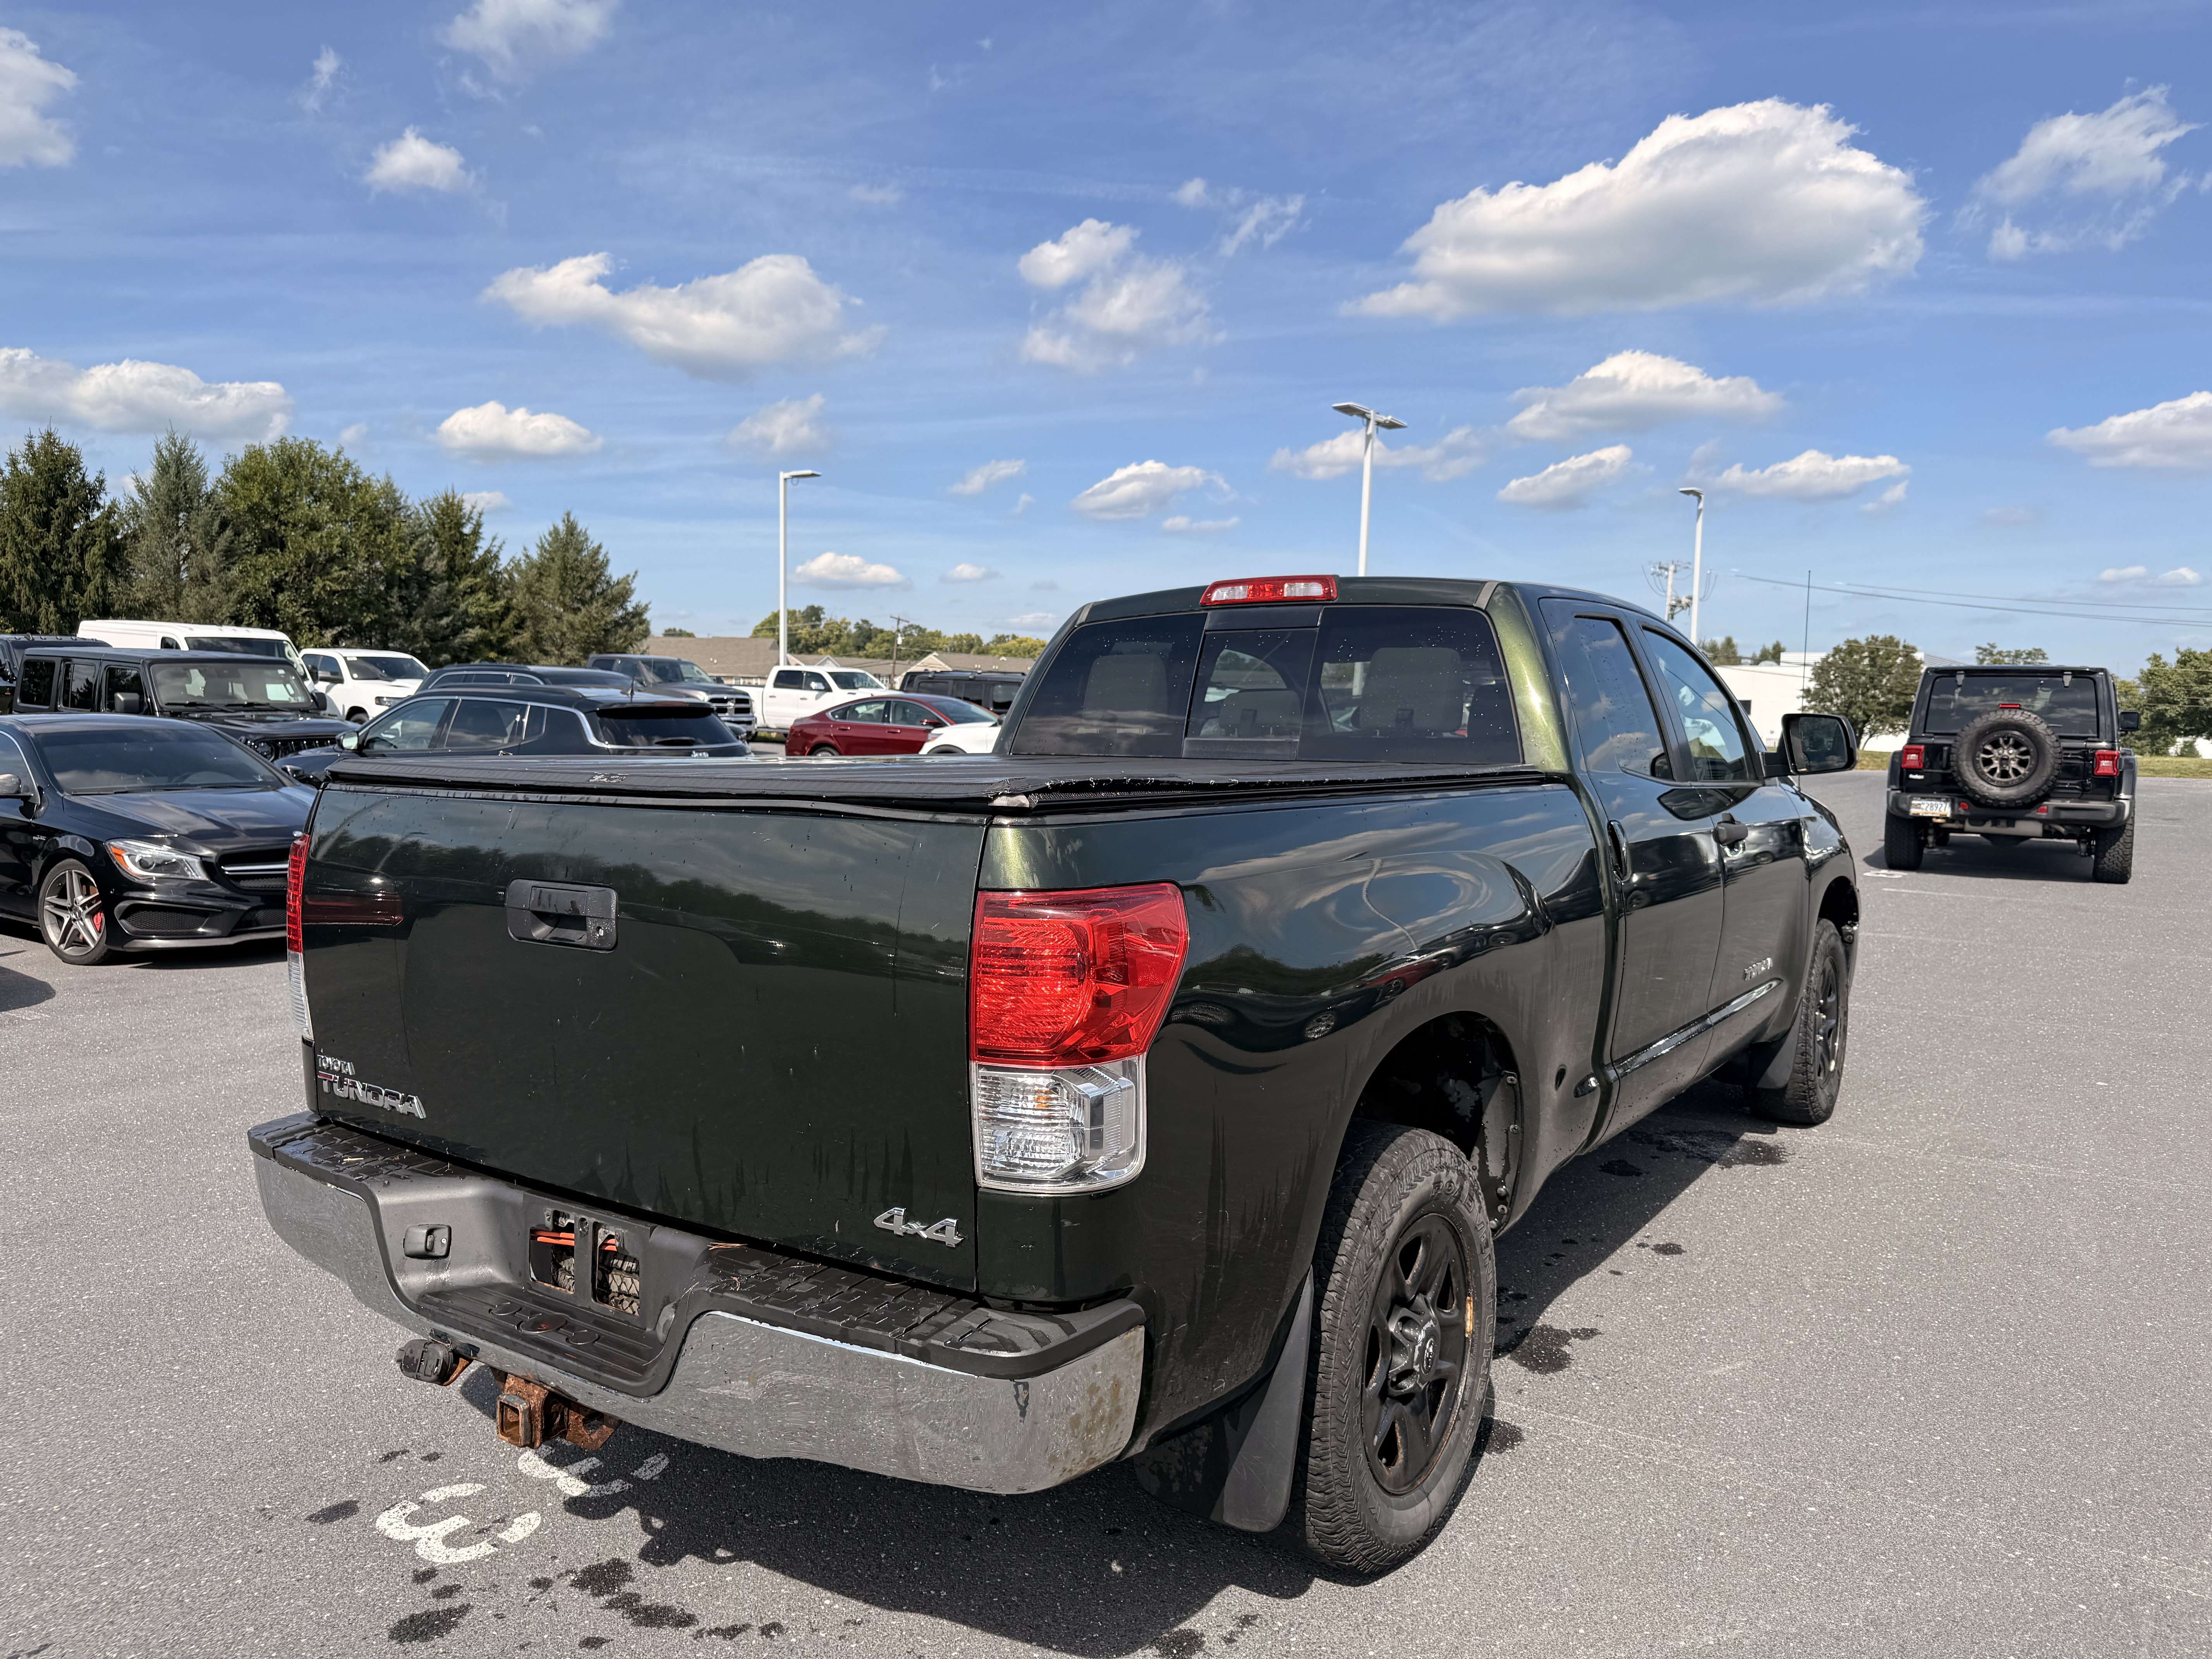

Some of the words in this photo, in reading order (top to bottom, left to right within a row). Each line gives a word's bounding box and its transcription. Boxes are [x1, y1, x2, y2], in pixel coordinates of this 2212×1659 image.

[317, 1054, 356, 1075] TOYOTA
[318, 1071, 426, 1119] TUNDRA
[1431, 1180, 1475, 1213] ROAD
[1473, 1211, 1494, 1401] VENTURE
